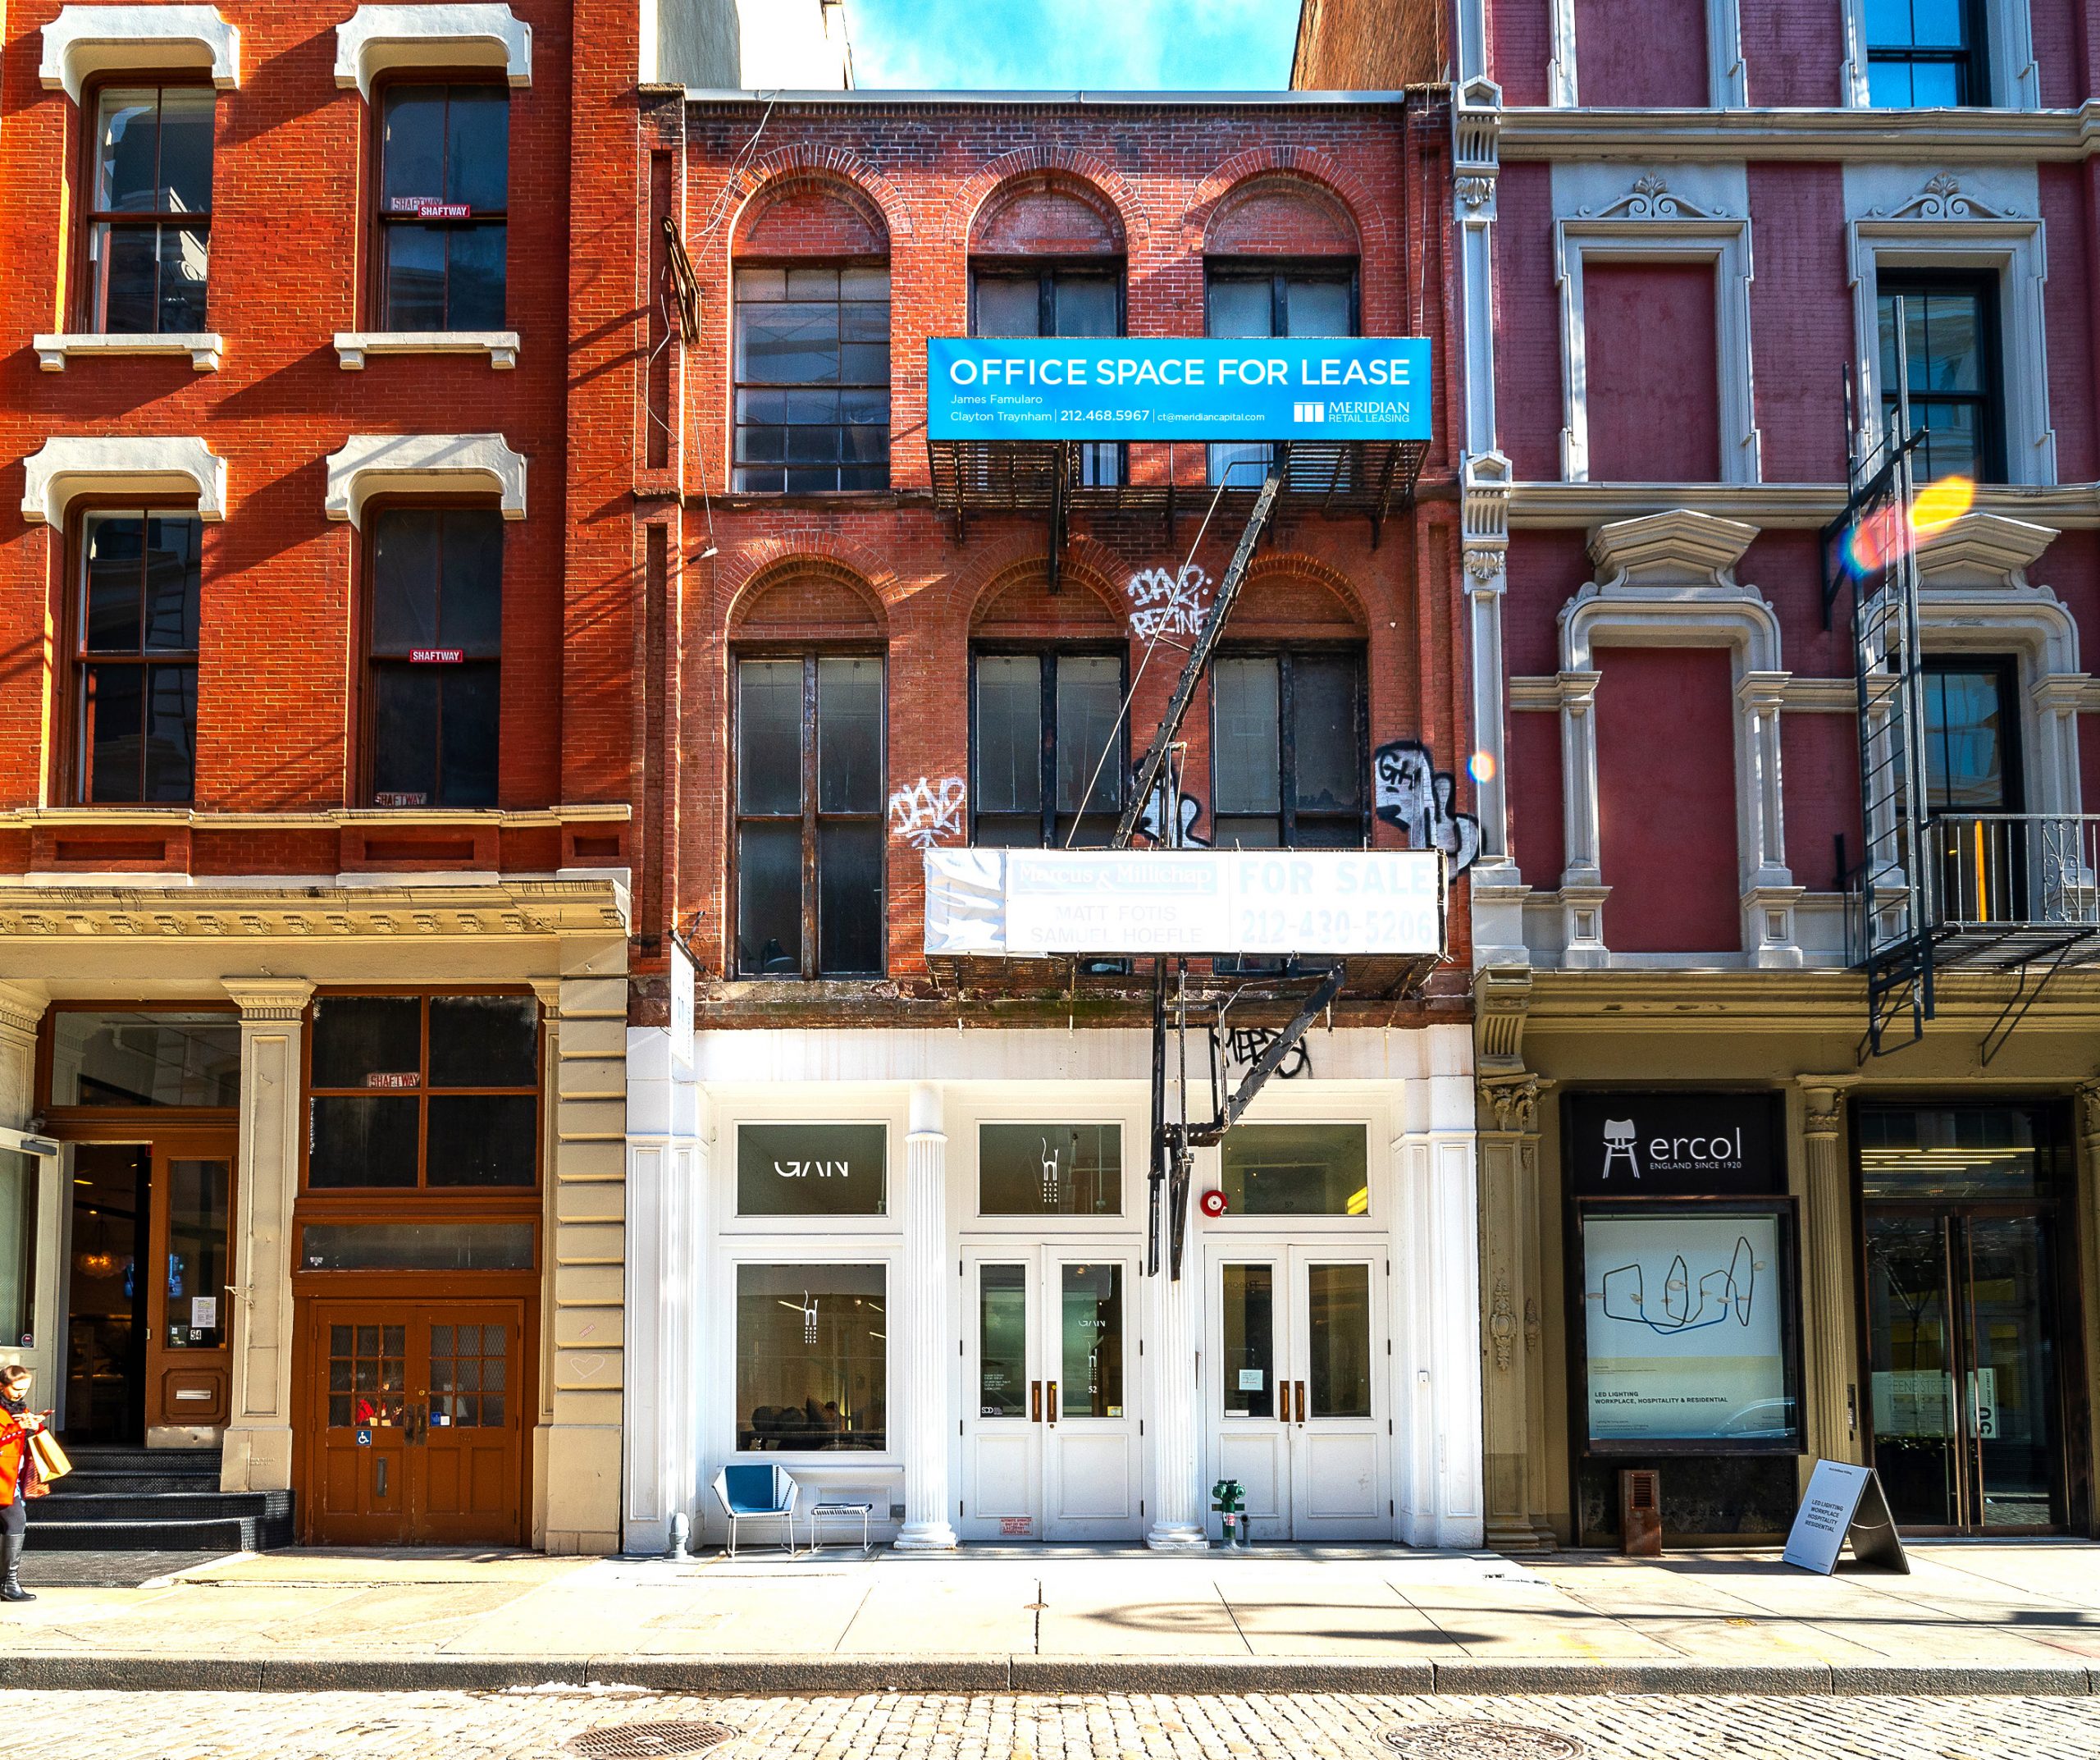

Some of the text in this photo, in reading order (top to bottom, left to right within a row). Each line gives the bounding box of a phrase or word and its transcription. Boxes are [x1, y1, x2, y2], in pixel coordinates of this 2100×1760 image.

[421, 207, 467, 216] SHAFTWAY
[950, 359, 1410, 385] OFFICE SPACE FOR LEASE
[950, 395, 1043, 404] James Famularo
[1329, 402, 1409, 414] MERIDIAN
[951, 410, 1265, 423] Clayton Traynham 212.468.5967 ct@meridiancapital.com
[413, 651, 459, 661] SHAFTWAY
[375, 793, 423, 807] SHAFTWAY
[1018, 862, 1212, 892] Marcus & Millichap
[1239, 861, 1432, 895] FOR SALE
[1056, 905, 1176, 921] MATT FOTIS
[1240, 909, 1433, 945] 212-430-5206
[1029, 927, 1116, 944] SAMUEL
[369, 1074, 419, 1087] SHAFTWAY
[1650, 1127, 1741, 1160] ercol
[190, 1329, 202, 1340] 54
[1089, 1385, 1098, 1393] 52
[1811, 1499, 1844, 1511] LED LIGHTING
[1810, 1506, 1840, 1518] WORKPLACE
[1807, 1513, 1838, 1525] HOSPITALITY
[1805, 1520, 1834, 1532] RESIDENTIAL
